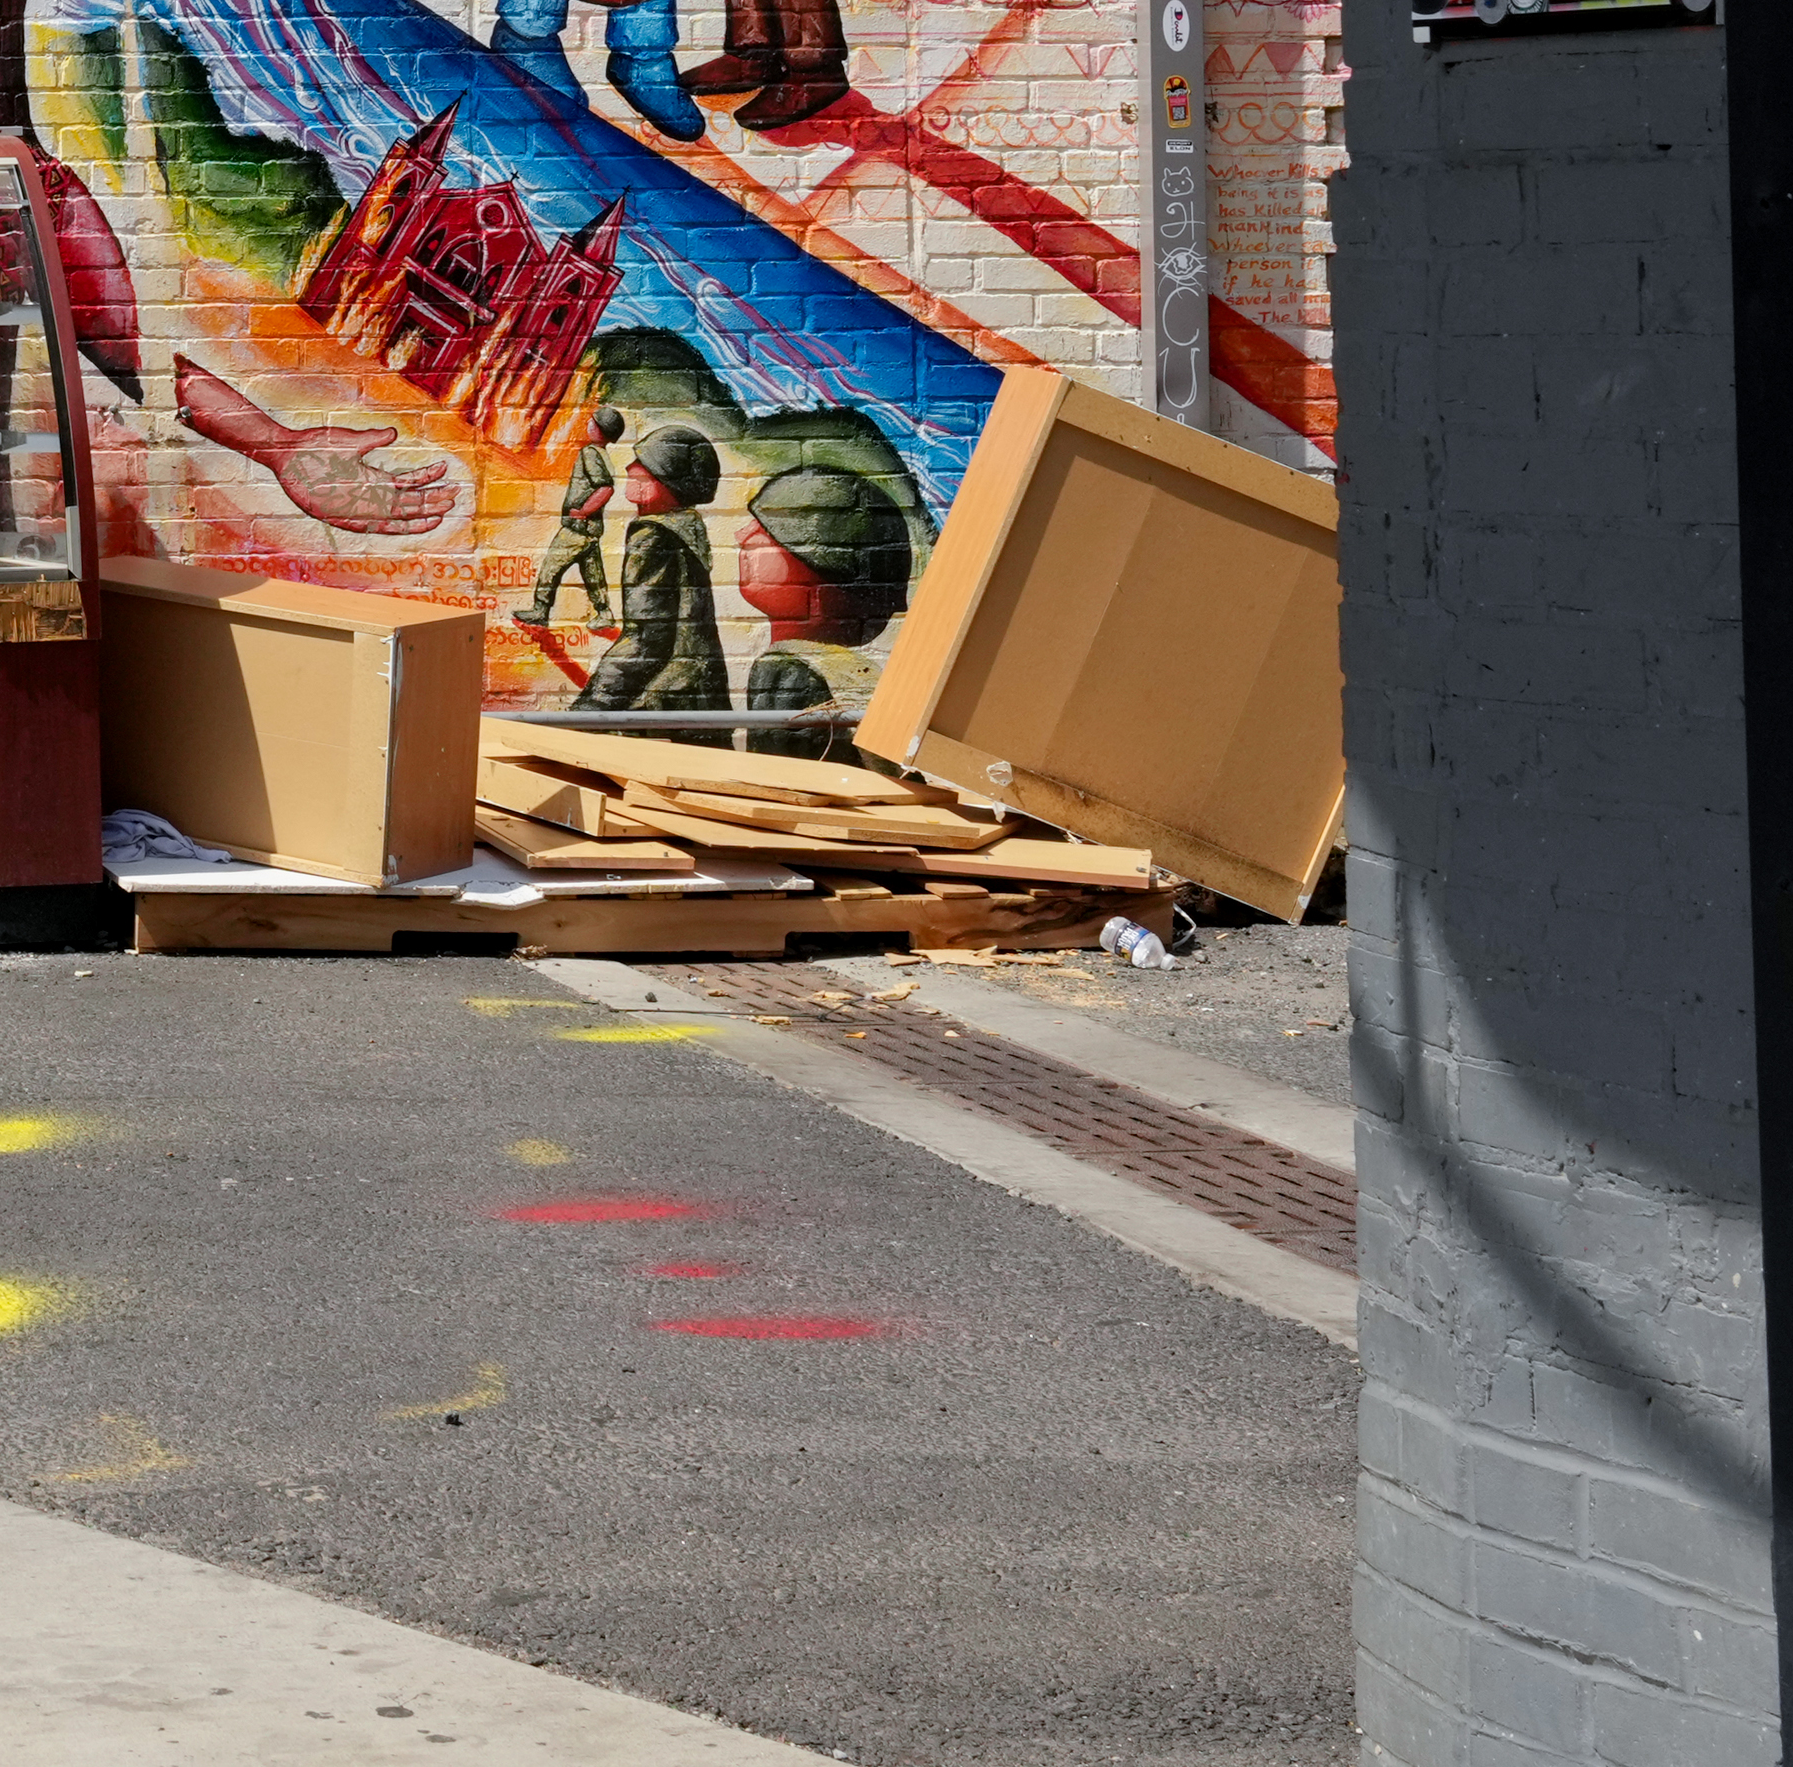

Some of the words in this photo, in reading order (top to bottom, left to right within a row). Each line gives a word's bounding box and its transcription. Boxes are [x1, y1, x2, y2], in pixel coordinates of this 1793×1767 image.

[1218, 186, 1258, 200] being
[1267, 186, 1278, 200] it
[1284, 186, 1300, 199] is
[1304, 188, 1324, 198] as
[1218, 204, 1246, 217] has
[1207, 237, 1297, 253] Whoever
[1226, 258, 1293, 275] person
[1301, 257, 1315, 270] it
[1222, 275, 1239, 295] if
[1251, 274, 1275, 288] he
[1284, 274, 1319, 289] has
[1225, 291, 1272, 306] saved
[1277, 292, 1298, 305] all
